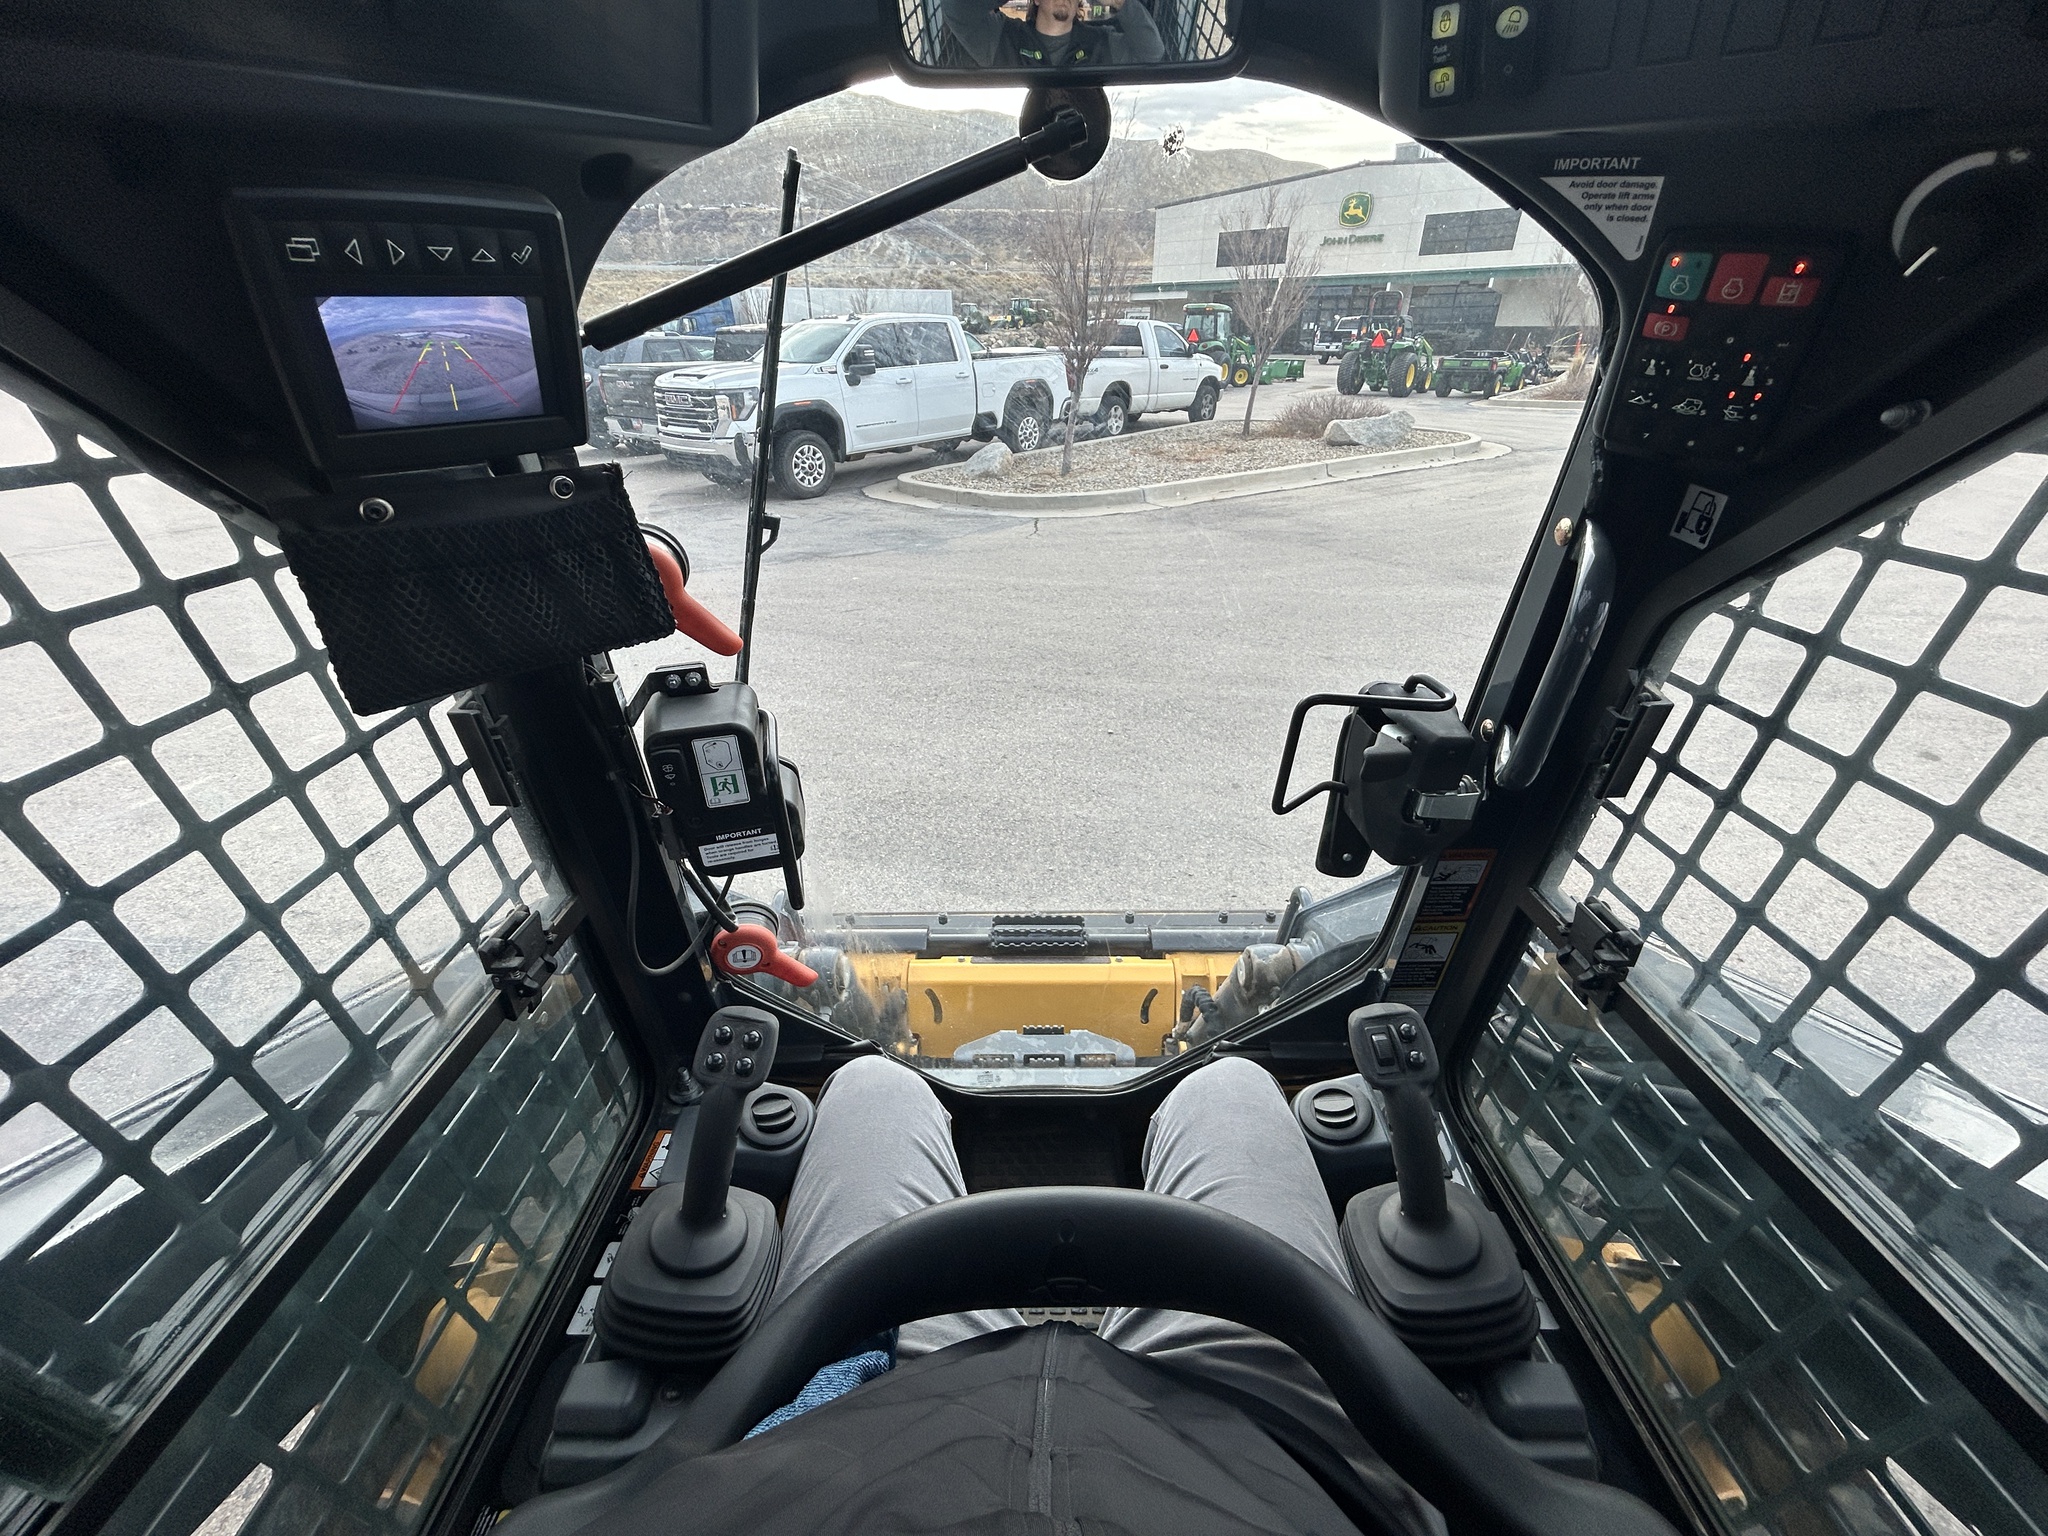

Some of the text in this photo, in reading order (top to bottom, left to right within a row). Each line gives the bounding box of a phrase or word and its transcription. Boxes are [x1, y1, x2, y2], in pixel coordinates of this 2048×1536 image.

[1553, 156, 1641, 170] IMPORTANT
[1568, 180, 1657, 190] Avoid door damage.
[1581, 192, 1616, 201] Operate
[1617, 191, 1631, 200] lift
[1583, 203, 1653, 212] only when door
[1606, 214, 1648, 222] is closed.
[665, 394, 689, 404] GMC
[715, 828, 762, 841] IMPORTANT
[640, 1140, 660, 1174] WARNING
